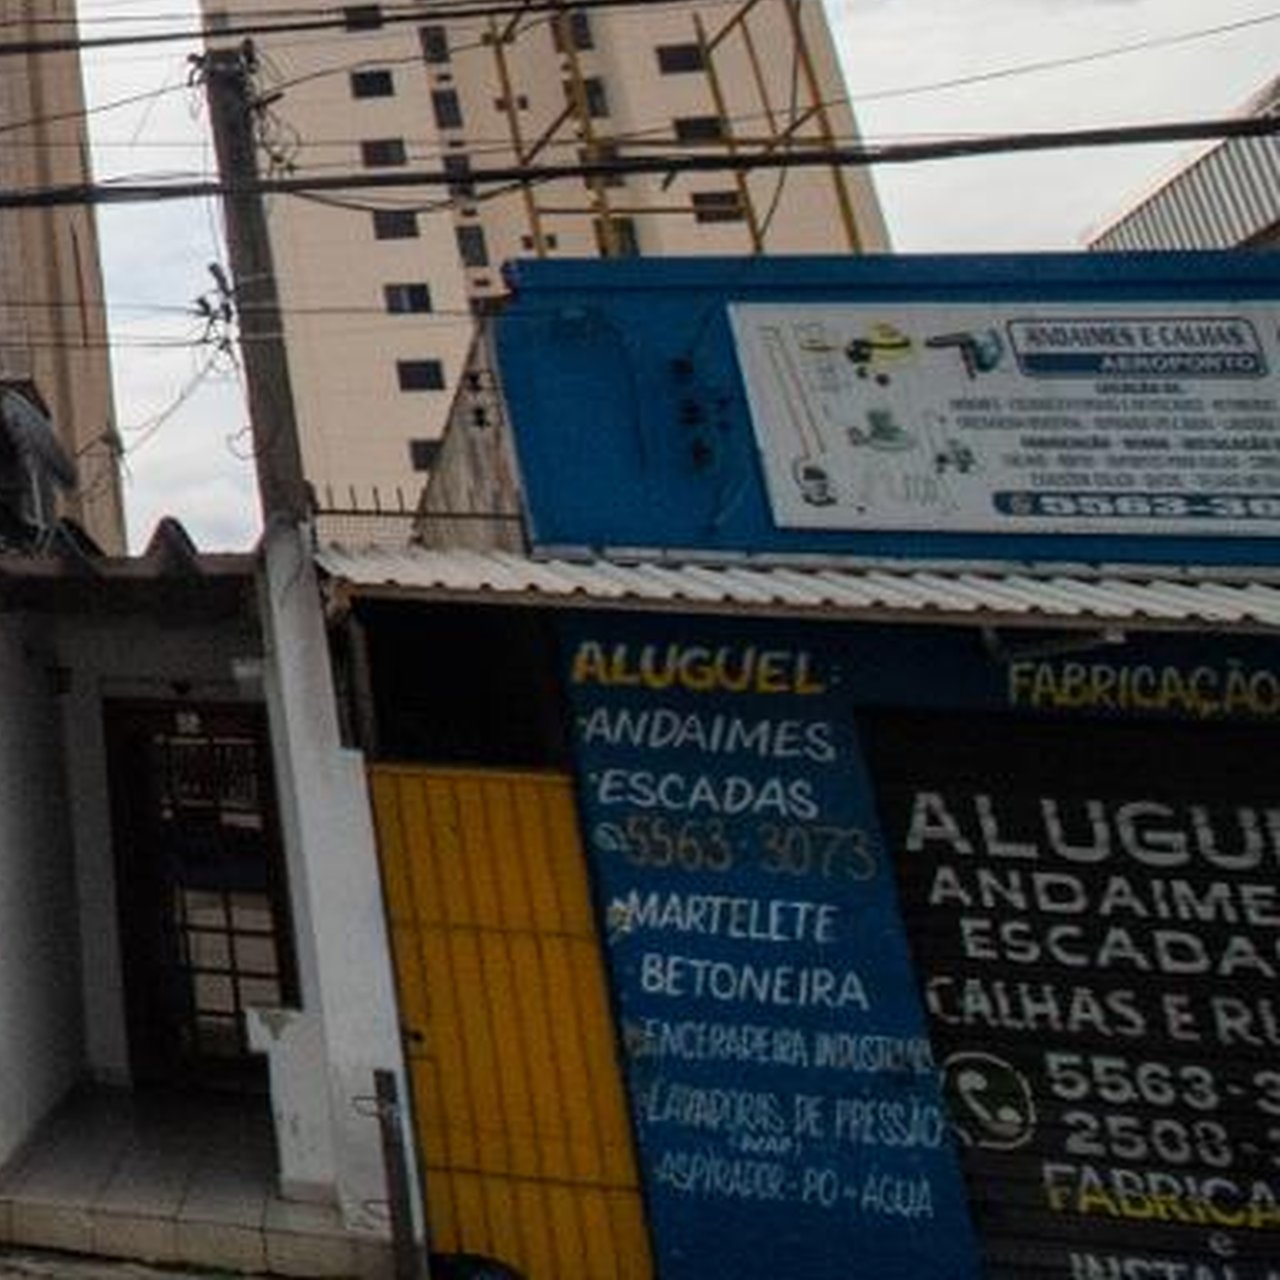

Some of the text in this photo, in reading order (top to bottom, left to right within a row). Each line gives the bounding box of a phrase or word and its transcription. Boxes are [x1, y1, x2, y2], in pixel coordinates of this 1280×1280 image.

[1140, 325, 1155, 347] E
[585, 706, 837, 763] ANDAIMES
[597, 768, 819, 820] ESCADAS
[626, 887, 841, 944] MARTELETE
[929, 865, 1280, 927] ANDAIME
[960, 917, 1280, 979] ESCADA
[641, 951, 872, 1012] BETONEIRA
[926, 975, 1145, 1038] CALHAS
[1162, 992, 1201, 1041] E
